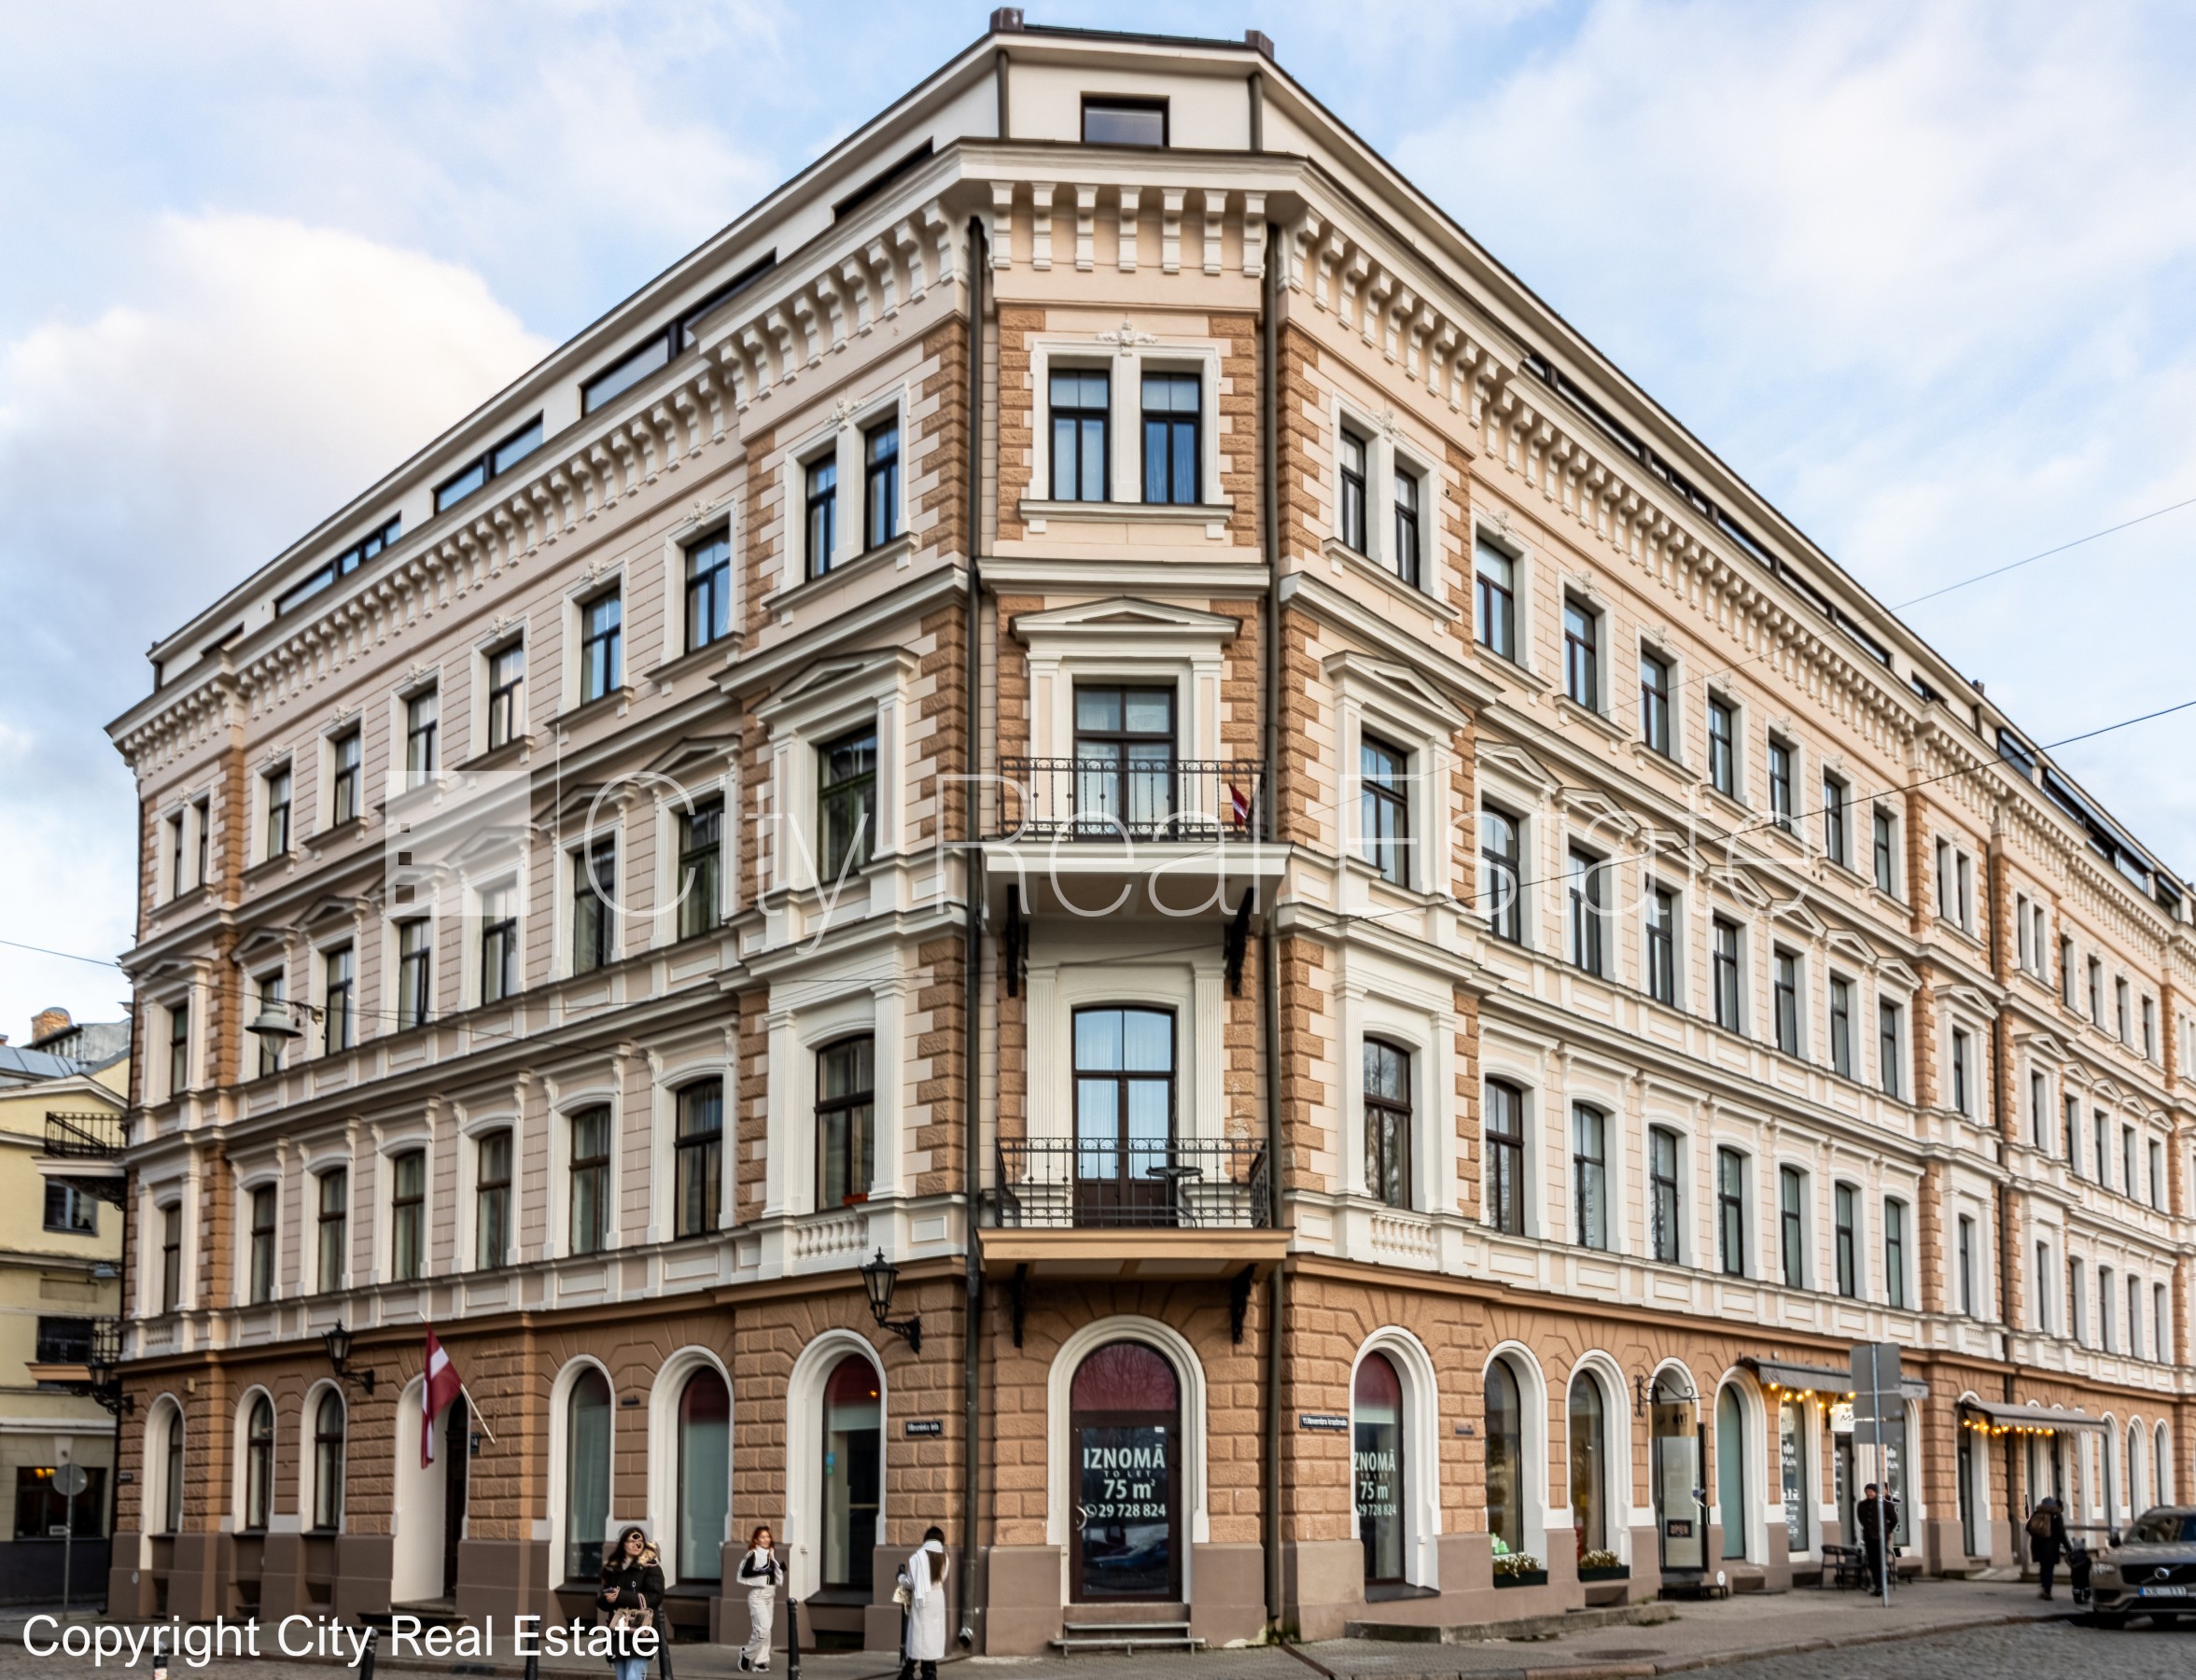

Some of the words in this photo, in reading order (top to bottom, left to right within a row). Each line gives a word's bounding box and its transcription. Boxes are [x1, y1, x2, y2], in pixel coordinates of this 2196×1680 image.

[1084, 1444, 1166, 1469] IZNOMĀ
[1354, 1449, 1396, 1472] ZNOMĀ
[1103, 1479, 1127, 1499] 75
[1360, 1481, 1375, 1500] 75
[1098, 1504, 1114, 1518] 29
[1117, 1504, 1140, 1518] 728
[1142, 1504, 1167, 1518] 824
[1358, 1504, 1367, 1517] 29
[1368, 1504, 1382, 1517] 728
[1383, 1504, 1397, 1517] 824
